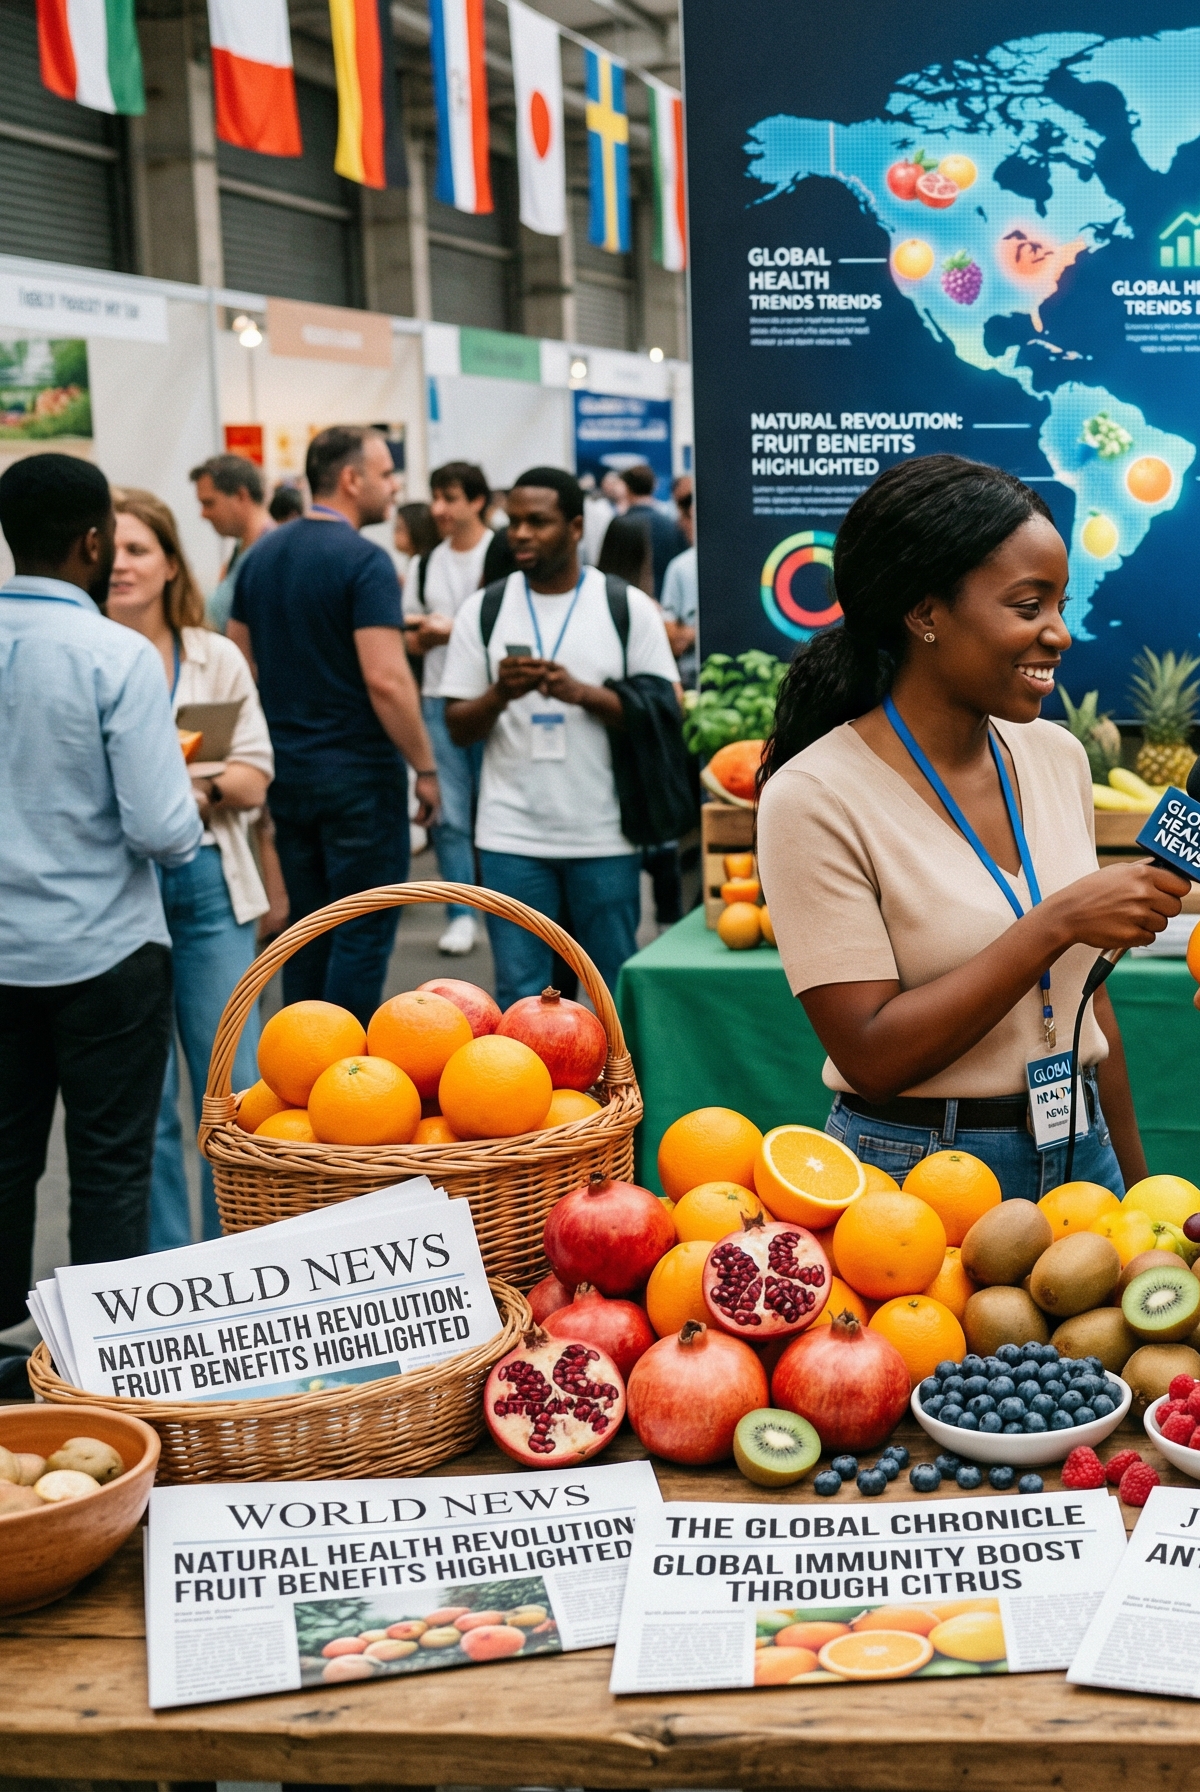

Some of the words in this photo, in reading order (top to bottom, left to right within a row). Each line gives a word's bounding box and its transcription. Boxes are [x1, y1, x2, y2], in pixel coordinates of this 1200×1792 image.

[748, 247, 831, 266] GLOBAL
[749, 271, 830, 290] HEALTH
[1111, 279, 1181, 296] GLOBAL
[749, 294, 814, 311] TRENDS
[816, 294, 882, 311] TRENDS
[1123, 299, 1193, 316] TRENDS
[751, 412, 837, 430] NATURAL
[840, 412, 963, 430] REVOLUTION:
[751, 434, 812, 454] FRUIT
[816, 434, 915, 454] BENEFITS
[752, 457, 880, 476] HIGHLIGHTED
[92, 1263, 290, 1324] WORLD
[301, 1232, 451, 1292] NEWS
[98, 1333, 214, 1373] NATURAL
[217, 1314, 312, 1353] HEALTH
[318, 1285, 472, 1335] REVOLUTION:
[112, 1367, 182, 1397] FRUIT
[190, 1345, 309, 1389] BENEFITS
[315, 1315, 471, 1367] HIGHLIGHTED
[226, 1497, 428, 1531] WORLD
[438, 1484, 590, 1519] NEWS
[665, 1516, 734, 1539] THE
[744, 1515, 881, 1539] GLOBAL
[890, 1505, 1086, 1535] CHRONICLE
[174, 1546, 318, 1575] NATURAL
[327, 1536, 442, 1565] HEALTH
[174, 1574, 266, 1603] FRUIT
[278, 1562, 427, 1596] BENEFITS
[437, 1540, 632, 1581] HIGHLIGHTED
[653, 1552, 785, 1577] GLOBAL
[795, 1546, 967, 1575] IMMUNITY
[977, 1539, 1084, 1566] BOOST
[726, 1575, 889, 1603] THROUGH
[900, 1568, 1023, 1597] CITRUS
